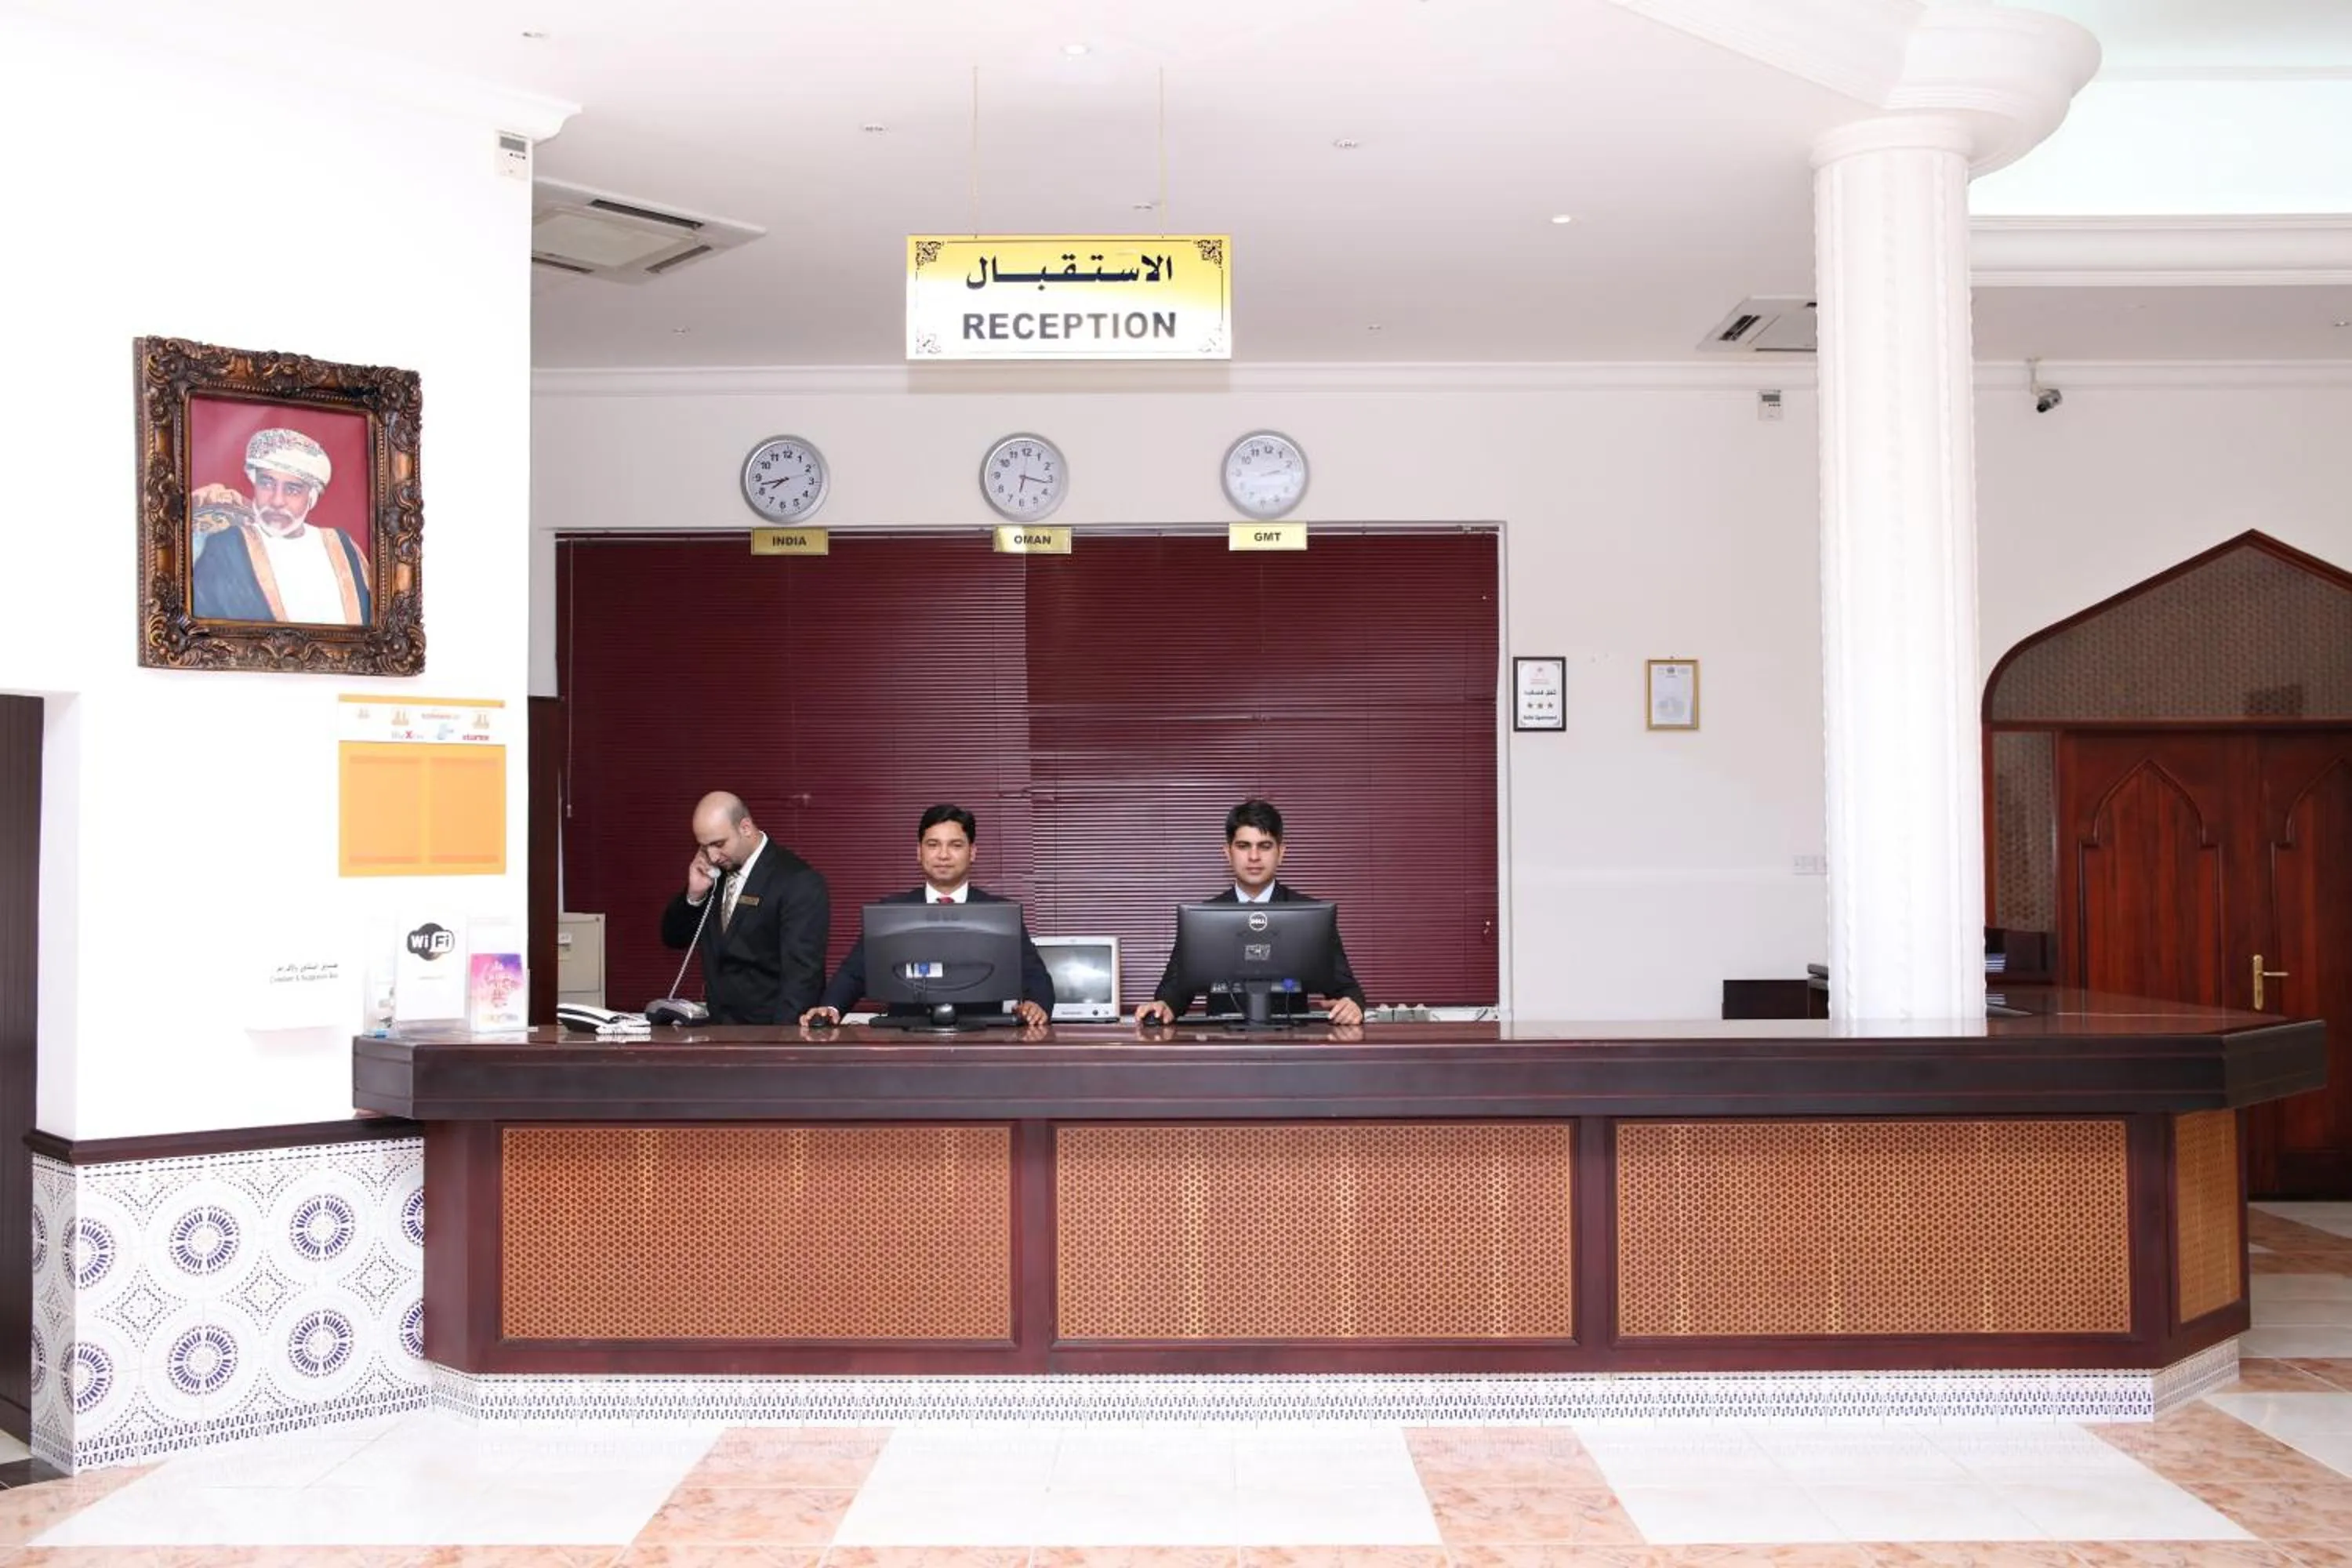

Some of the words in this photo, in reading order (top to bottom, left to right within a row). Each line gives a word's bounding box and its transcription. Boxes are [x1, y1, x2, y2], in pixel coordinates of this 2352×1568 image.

[966, 255, 1174, 290] الاستقبال
[963, 313, 1177, 339] RECEPTION
[771, 453, 779, 462] 11
[782, 450, 793, 459] 12
[797, 455, 802, 463] 1
[760, 461, 771, 470] 10
[805, 464, 811, 473] 2
[755, 473, 762, 482] 9
[809, 477, 815, 485] 3
[758, 487, 765, 495] 8
[779, 501, 786, 510] 6
[793, 498, 800, 507] 5
[772, 536, 807, 546] INDIA
[1014, 535, 1051, 544] OMAN
[1254, 532, 1281, 542] GMT
